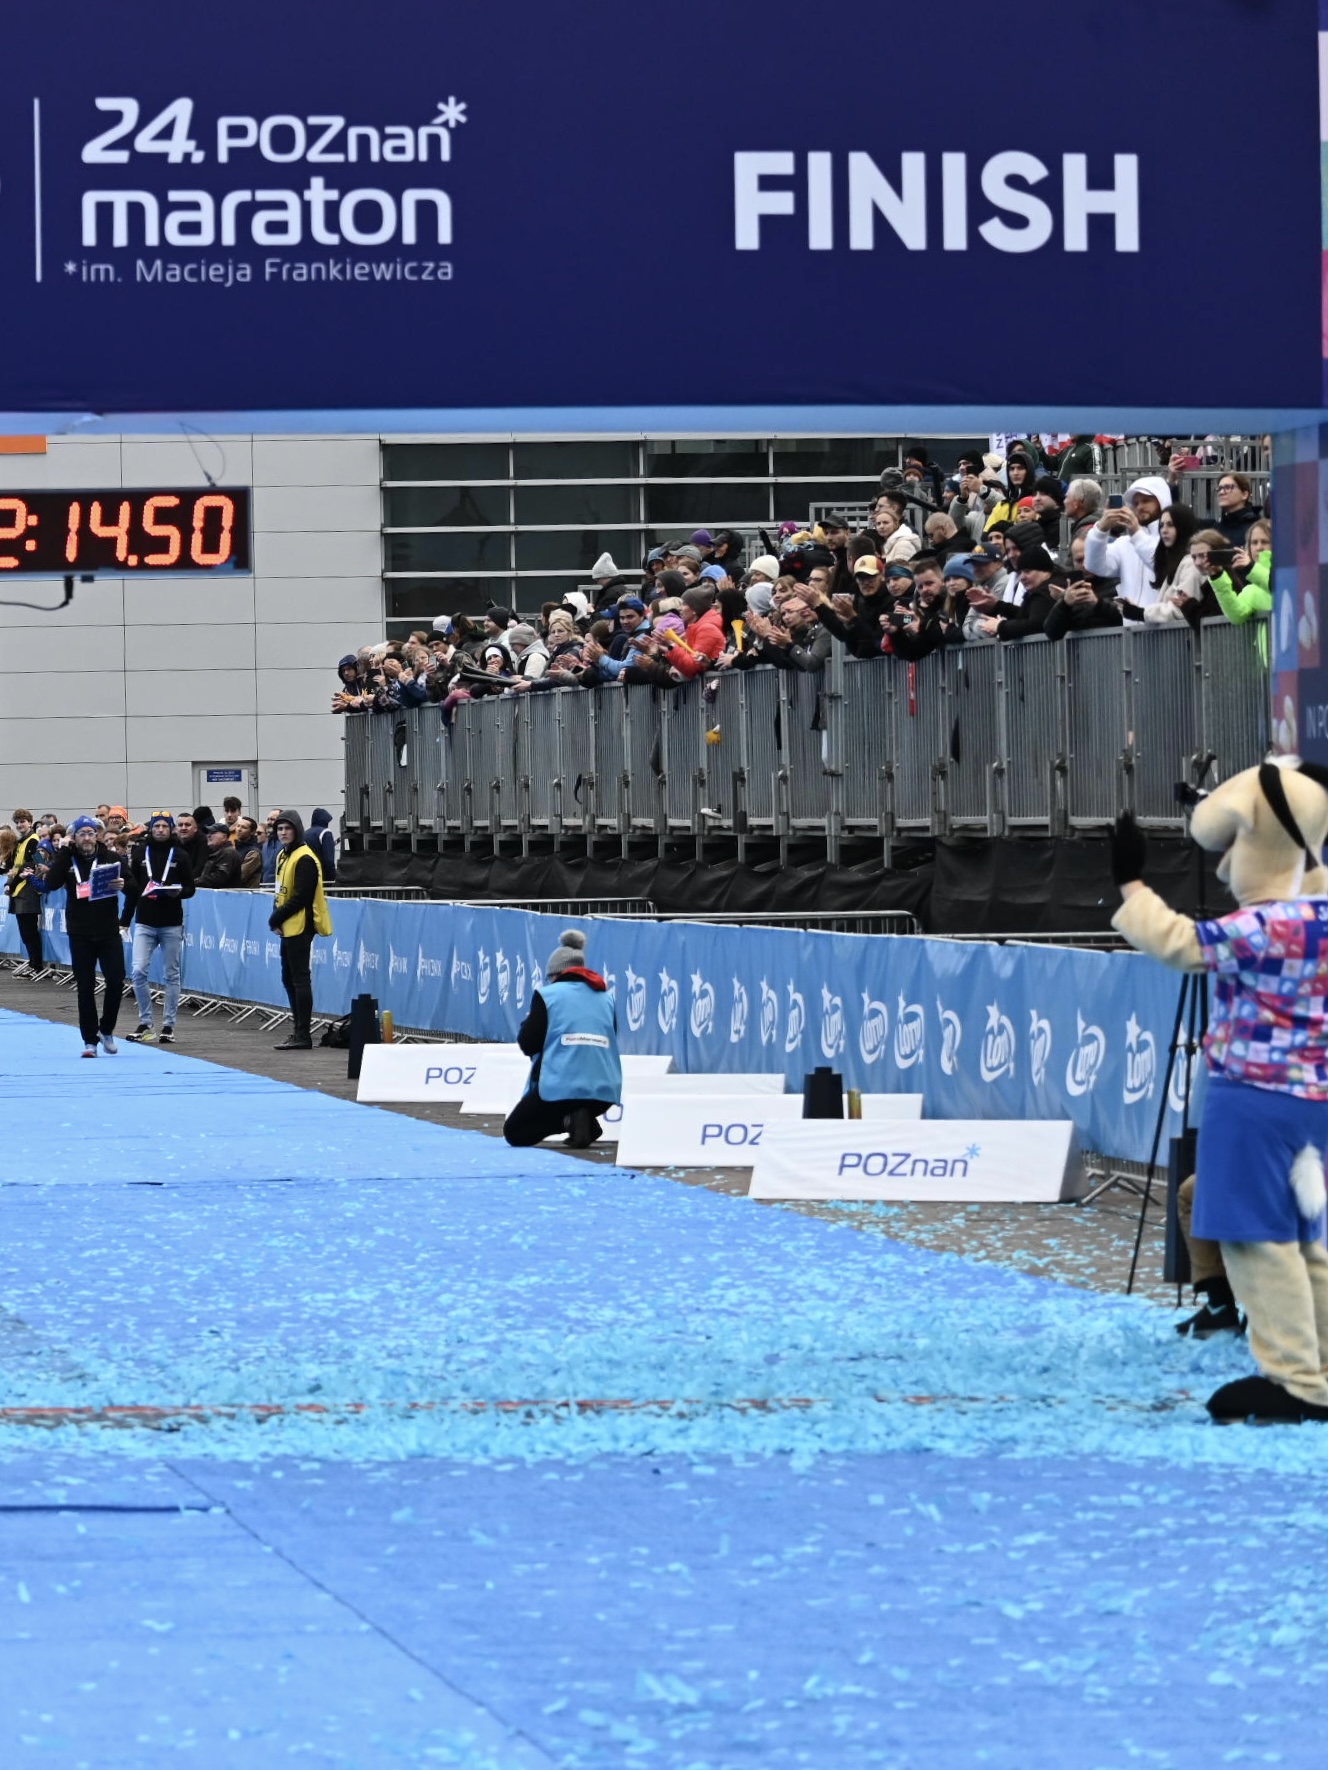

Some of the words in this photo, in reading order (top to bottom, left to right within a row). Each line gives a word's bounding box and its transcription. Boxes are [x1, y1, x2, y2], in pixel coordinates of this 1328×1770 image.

[81, 96, 205, 164] 24.
[81, 176, 452, 248] maraton
[734, 150, 1139, 253] FINISH
[136, 259, 252, 287] Macieja
[264, 257, 453, 282] Frankiewicza
[425, 1067, 477, 1085] POZ
[701, 1124, 764, 1146] POZ
